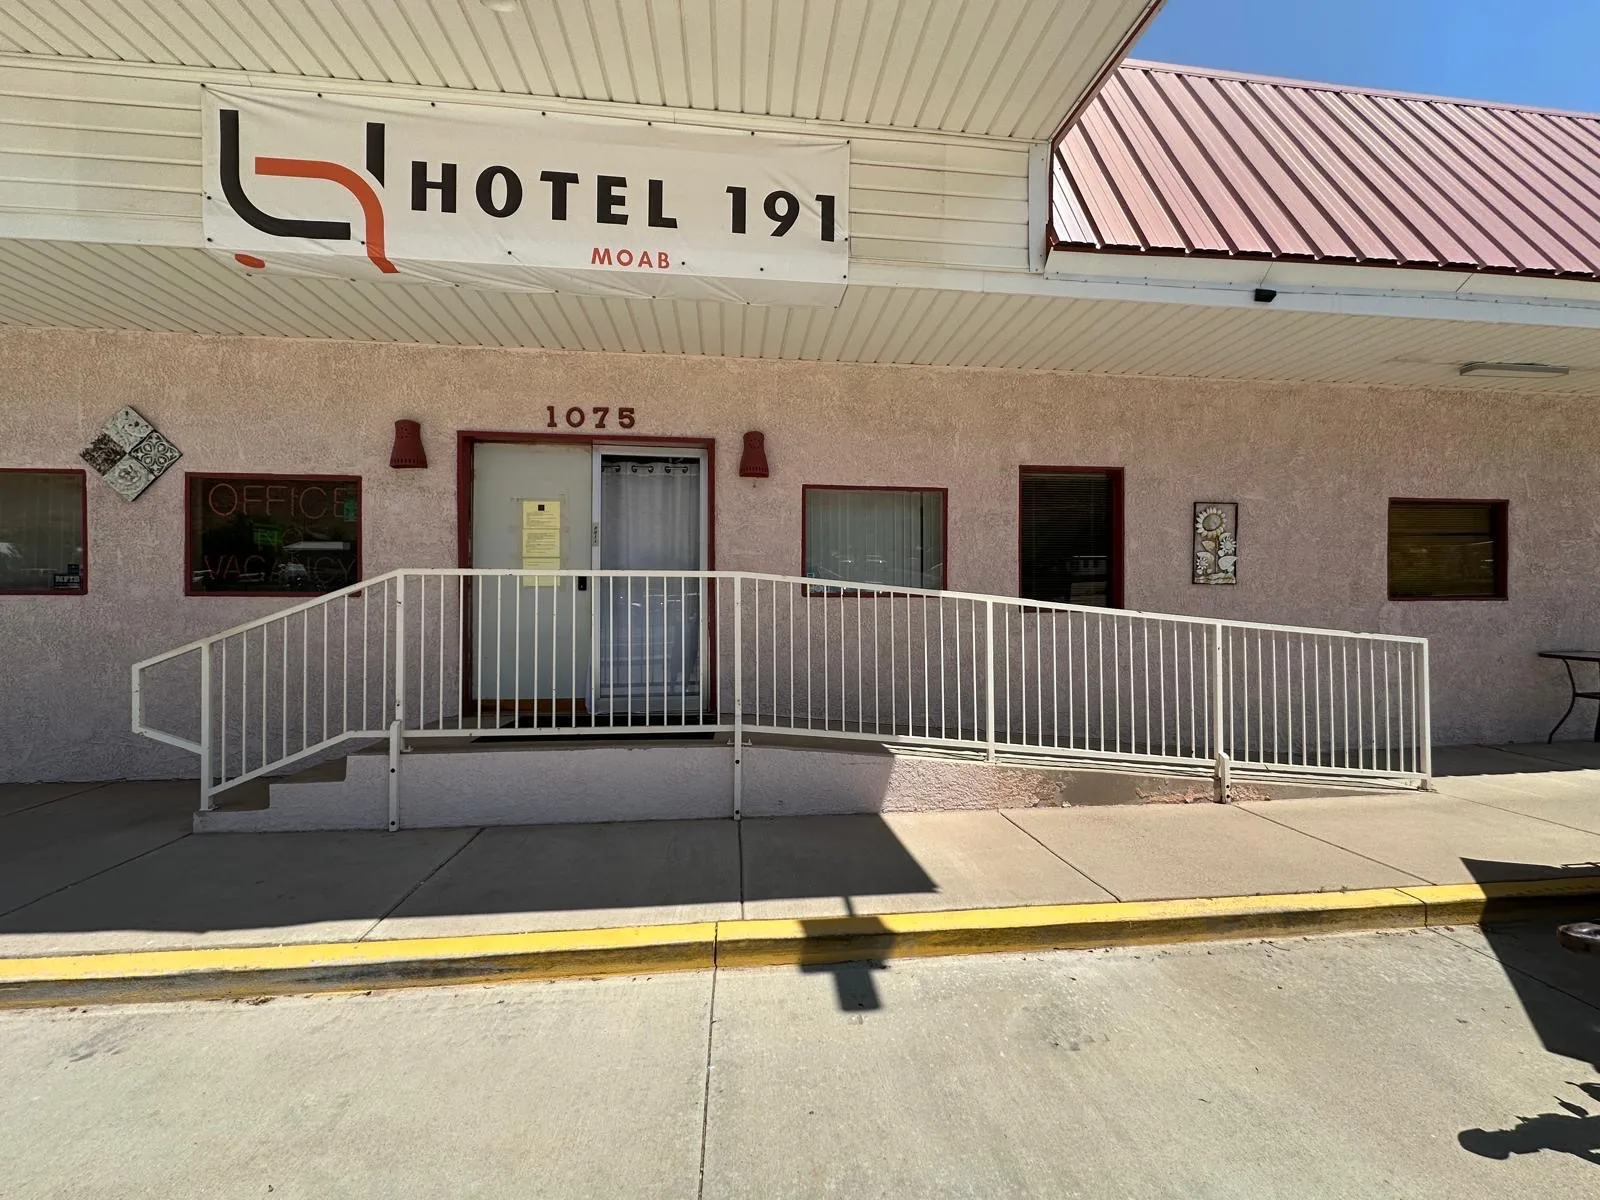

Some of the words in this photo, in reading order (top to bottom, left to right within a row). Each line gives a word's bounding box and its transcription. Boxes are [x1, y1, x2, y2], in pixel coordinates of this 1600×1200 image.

[411, 160, 678, 229] HOTEL
[725, 185, 836, 243] 191
[591, 247, 670, 269] MOAB
[546, 405, 636, 429] 1075
[208, 482, 356, 520] OFFICE
